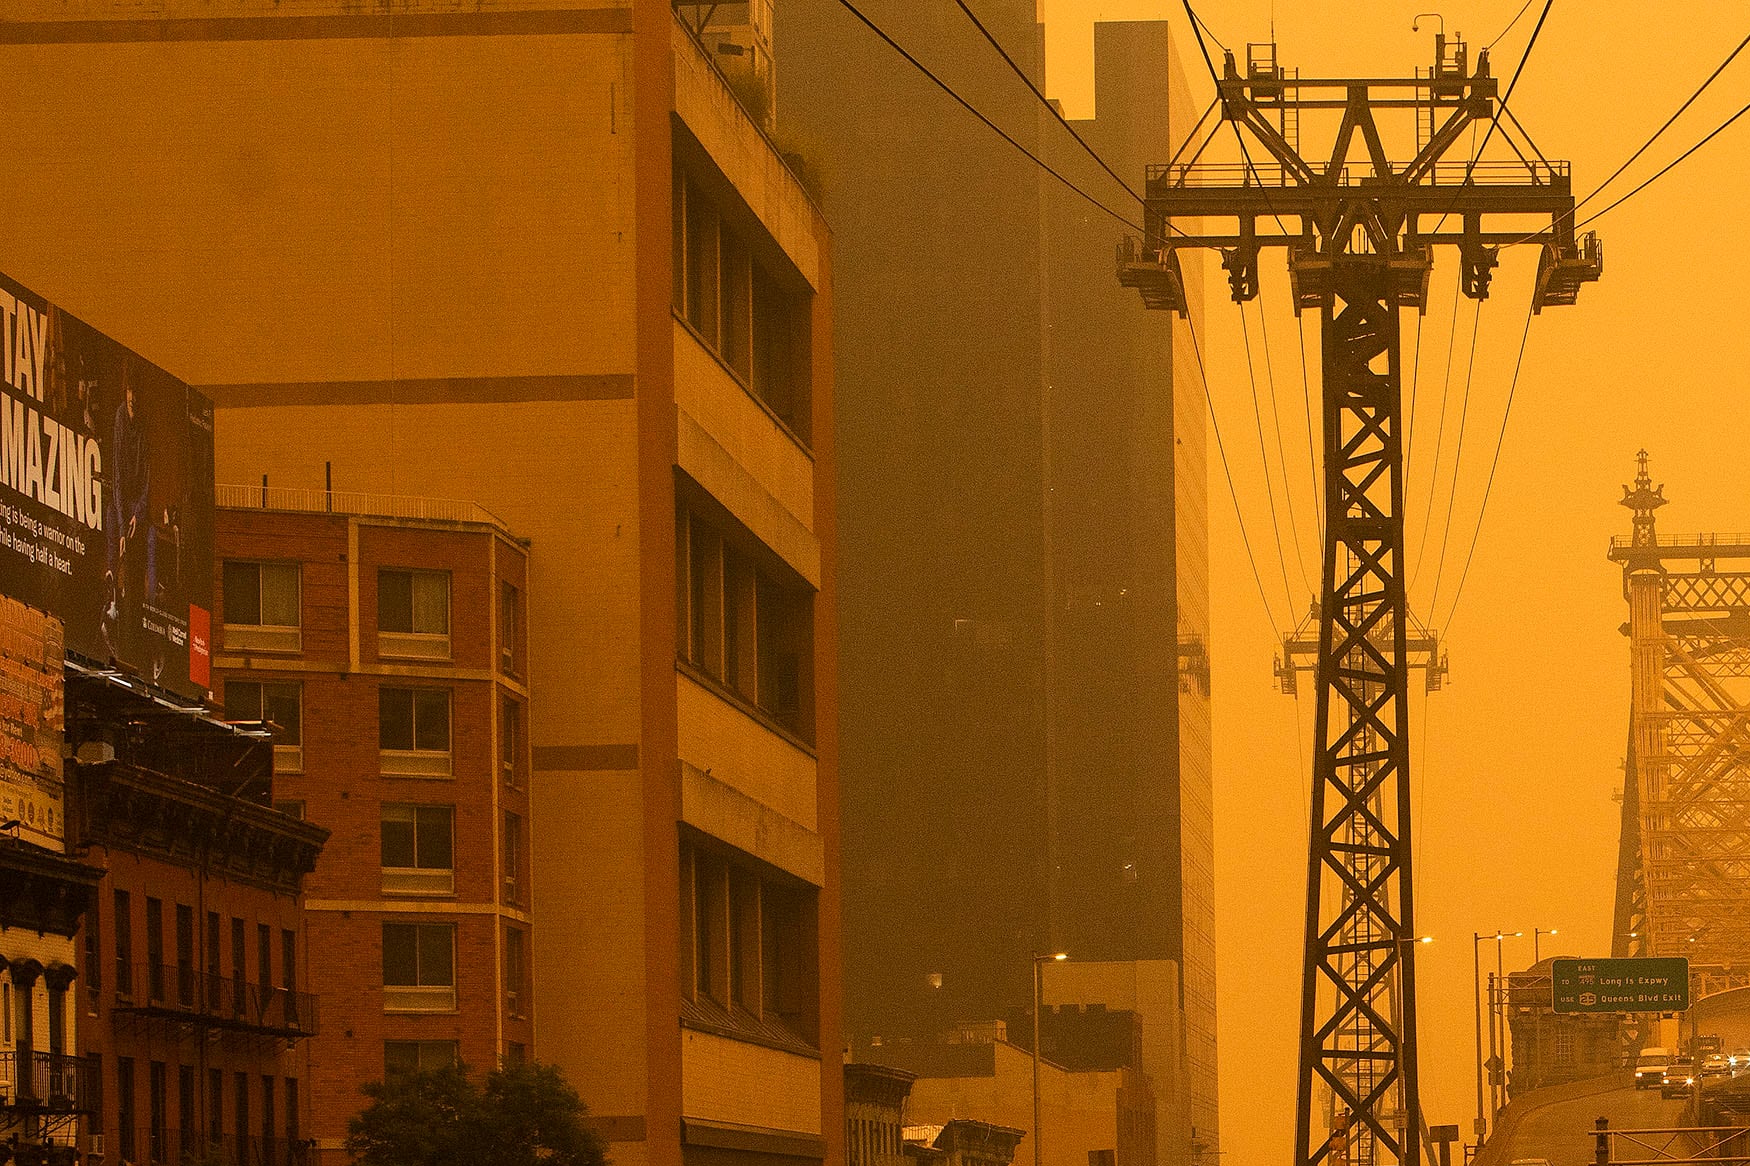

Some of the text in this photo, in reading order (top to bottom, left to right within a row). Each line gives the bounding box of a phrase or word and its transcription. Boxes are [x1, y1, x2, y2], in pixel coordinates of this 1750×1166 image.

[0, 392, 102, 531] MAZING
[12, 505, 18, 524] is
[19, 508, 37, 538] being
[38, 522, 43, 536] a
[43, 524, 65, 546] warrior
[65, 535, 74, 551] on
[75, 536, 86, 556] the
[12, 532, 35, 563] having
[36, 543, 48, 564] half
[48, 554, 53, 567] a
[54, 552, 72, 576] heart.
[1600, 977, 1622, 987] Long
[1639, 976, 1669, 986] Expwy
[1601, 995, 1634, 1003] Queens
[1638, 994, 1659, 1002] Blvd
[1662, 994, 1681, 1002] Exit
